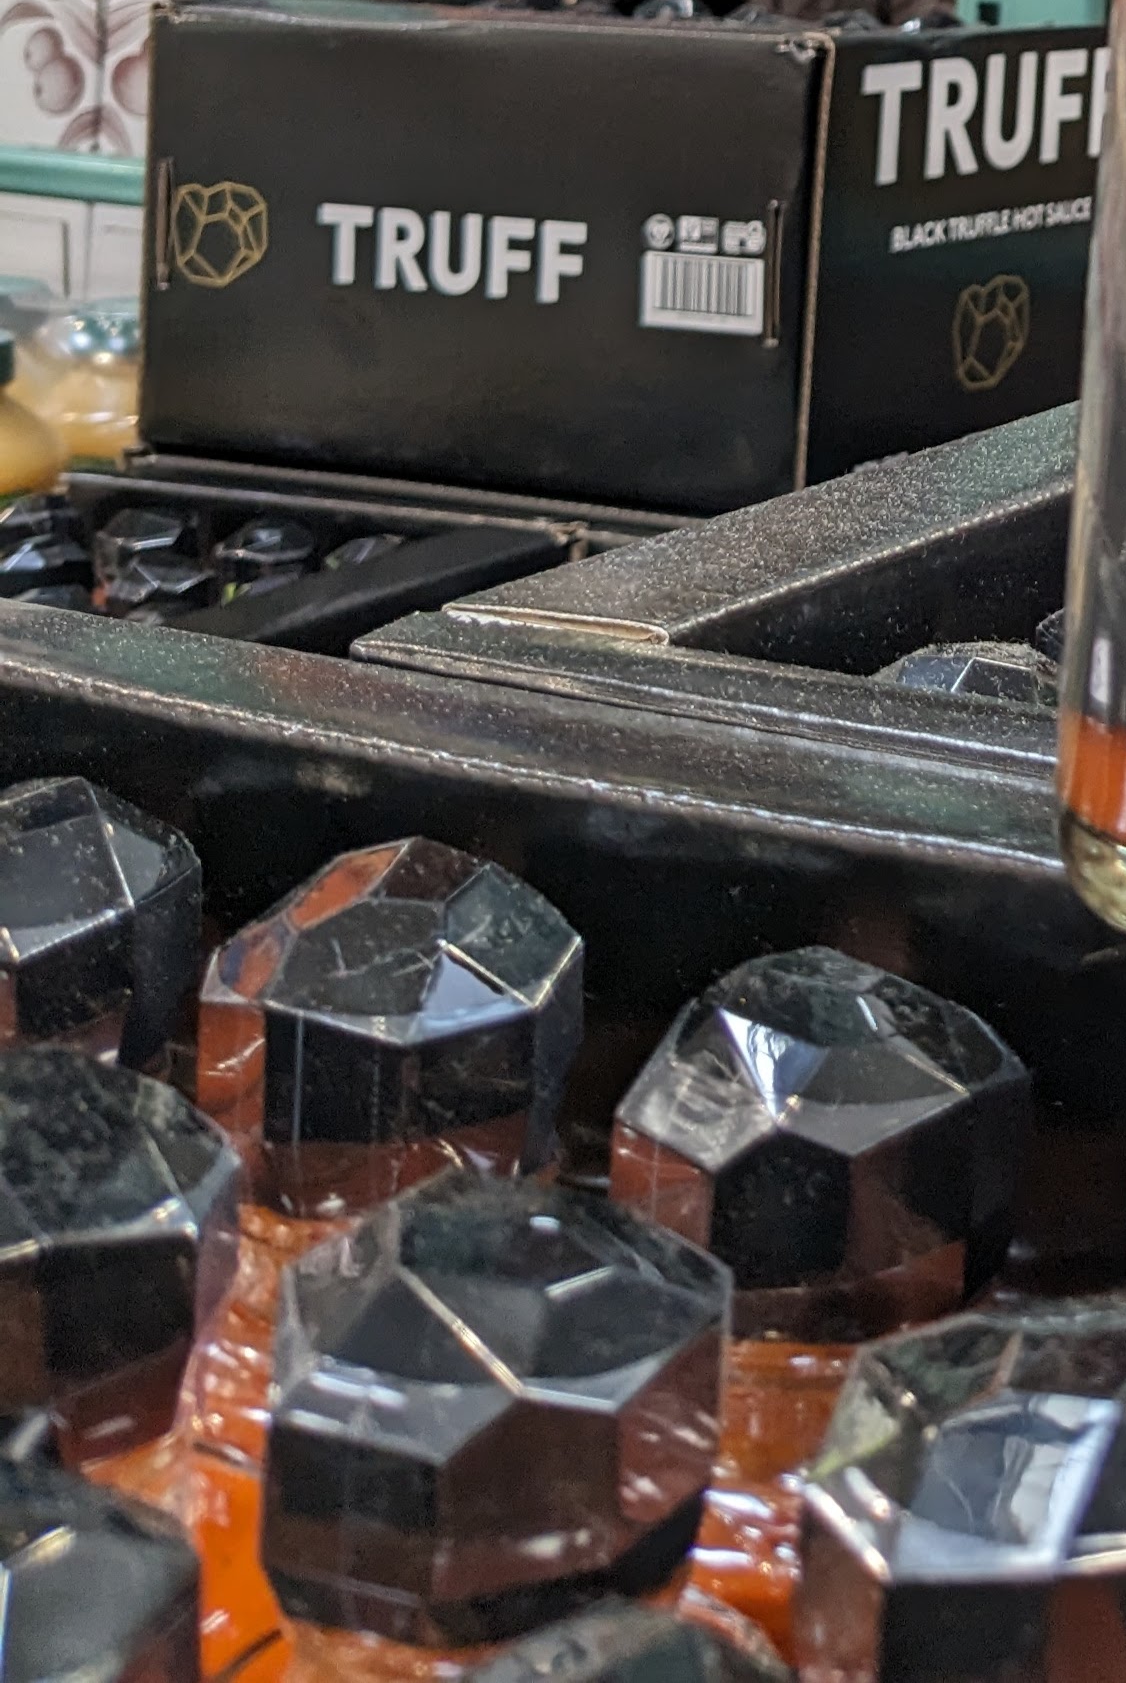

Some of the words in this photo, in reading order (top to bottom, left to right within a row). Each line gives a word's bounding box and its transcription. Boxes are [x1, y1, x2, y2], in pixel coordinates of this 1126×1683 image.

[316, 201, 589, 305] TRUFF
[889, 218, 947, 254] BLACK
[948, 208, 1012, 242] TRUFFLE
[1013, 202, 1046, 231] HOT
[1045, 195, 1093, 225] SAUCE
